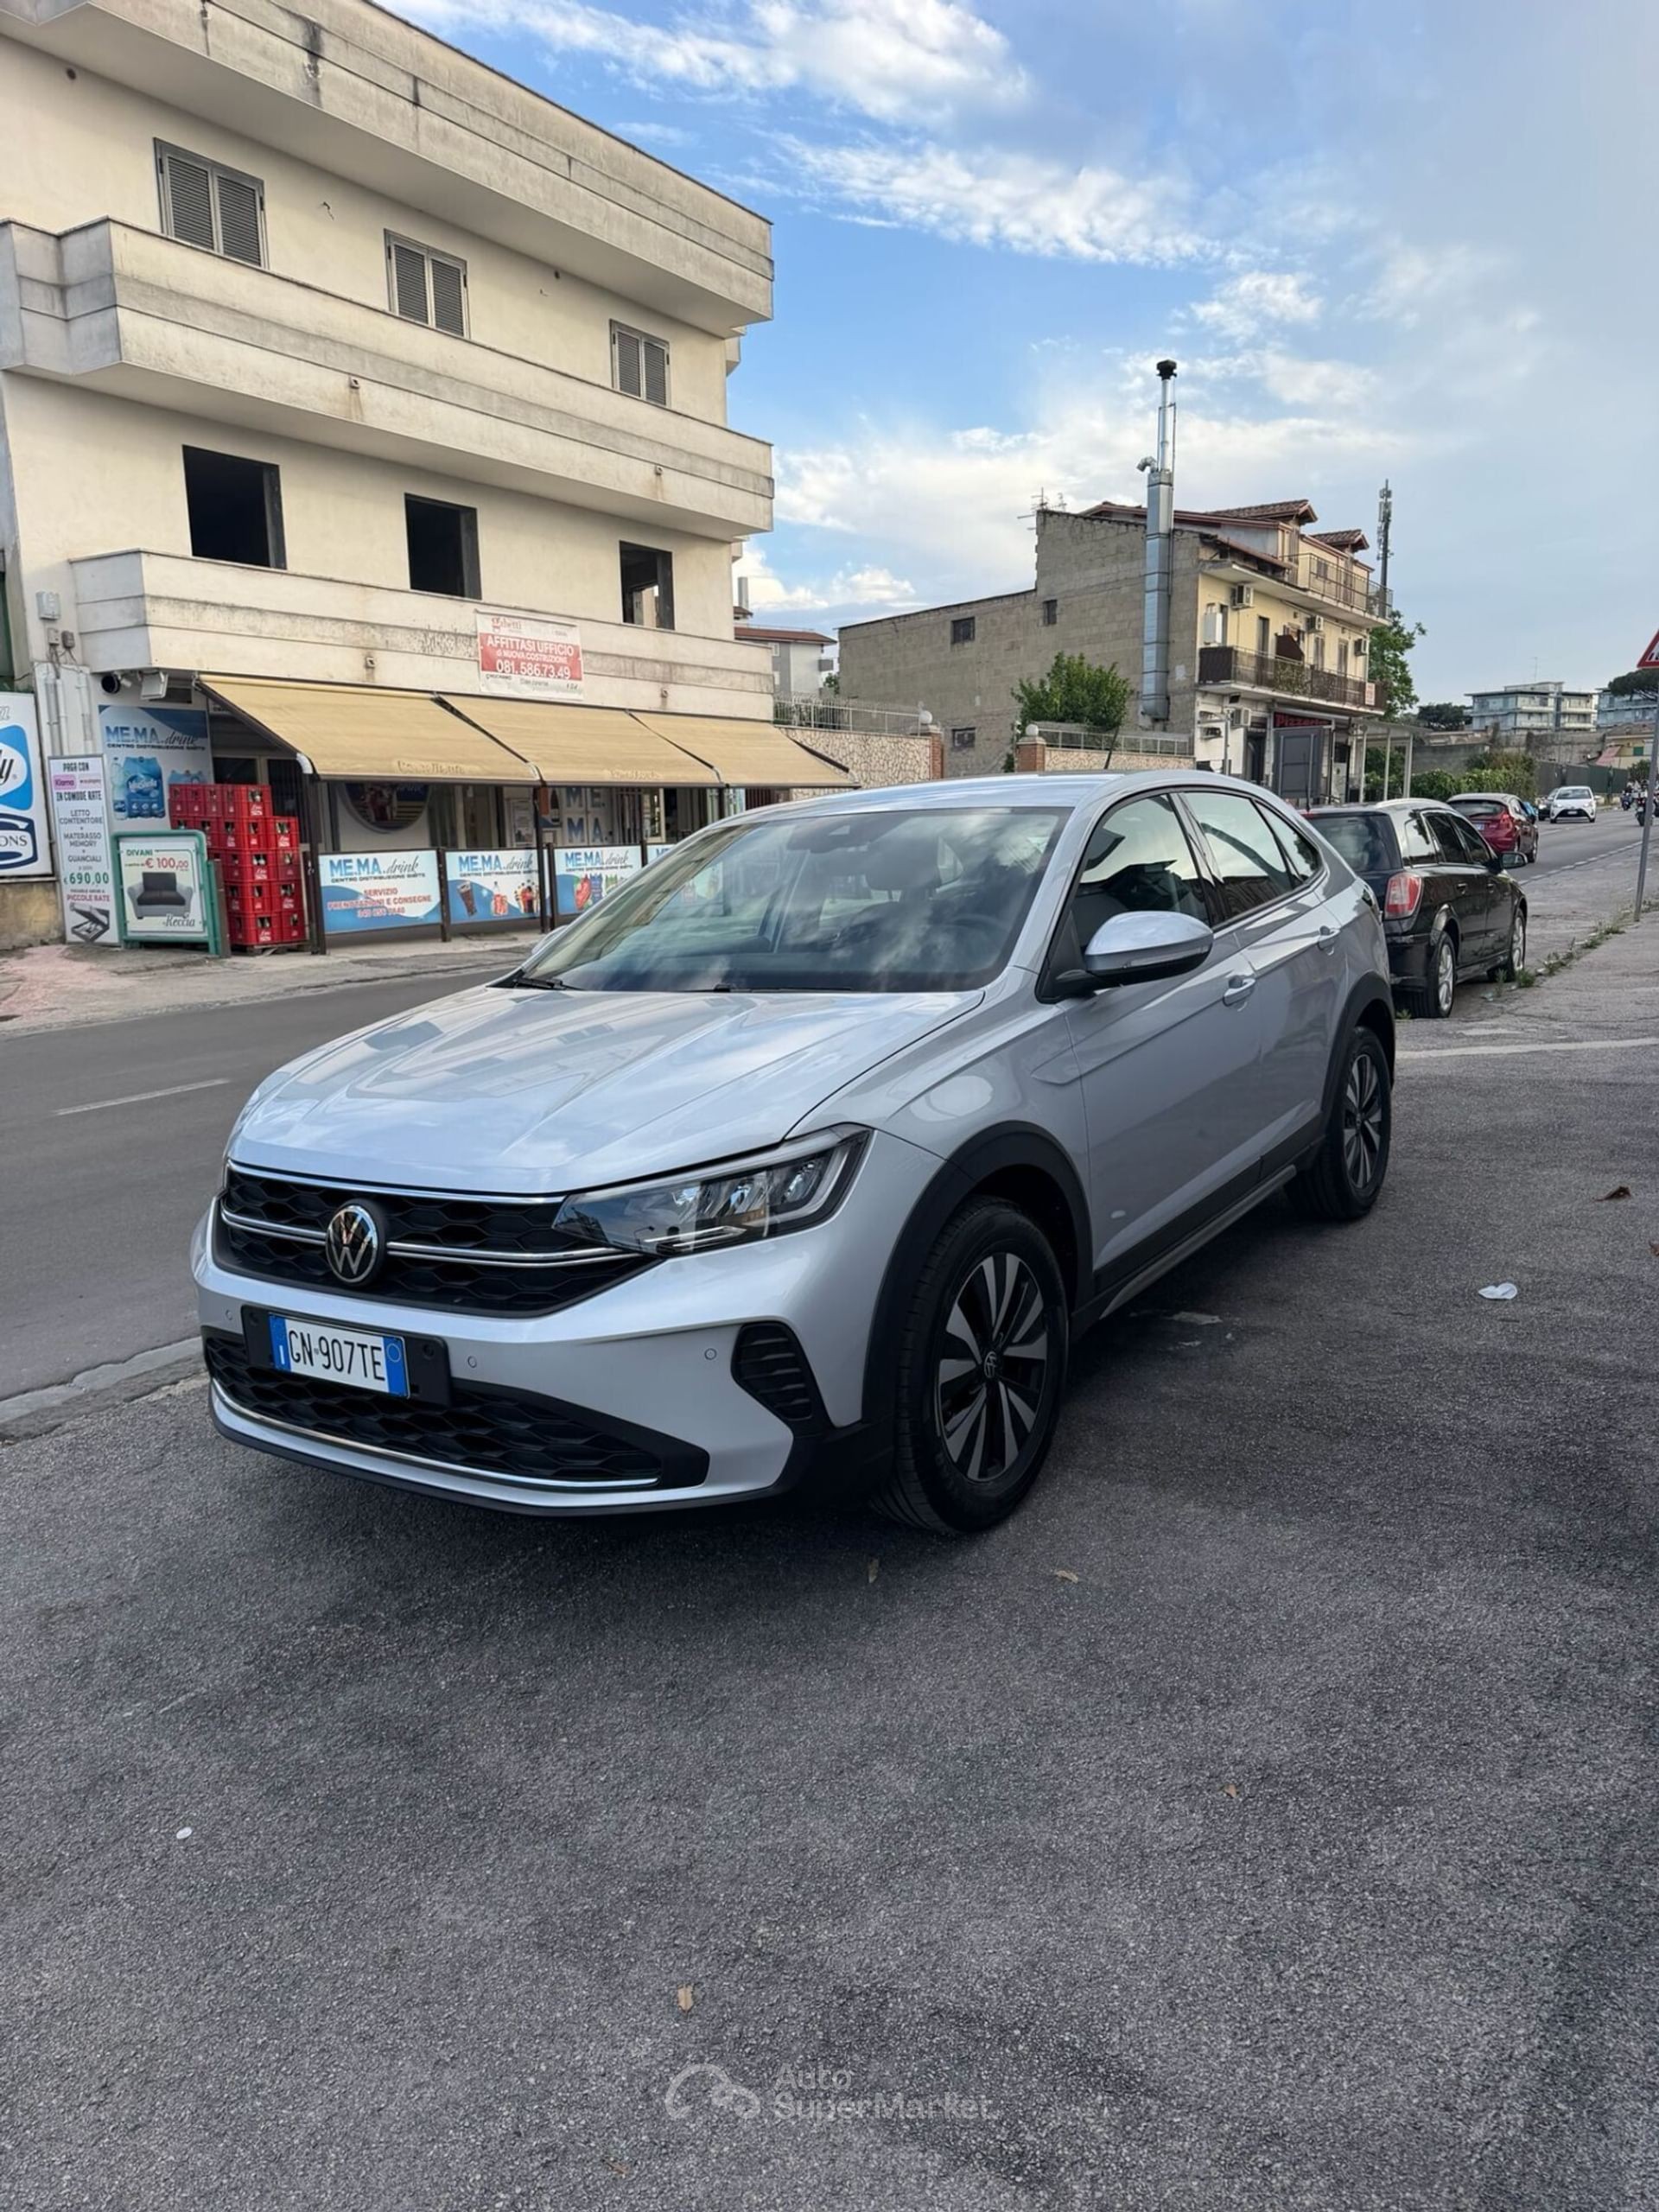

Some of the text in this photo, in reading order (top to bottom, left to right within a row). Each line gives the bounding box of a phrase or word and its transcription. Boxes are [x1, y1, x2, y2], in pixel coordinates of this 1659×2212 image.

[487, 634, 575, 657] AFFITTASI UFFICIO
[503, 650, 525, 660] NUOVA
[526, 652, 569, 664] COSTRUZIONE
[364, 887, 398, 896] SERVIZIO
[392, 895, 432, 905] CONSEGNE
